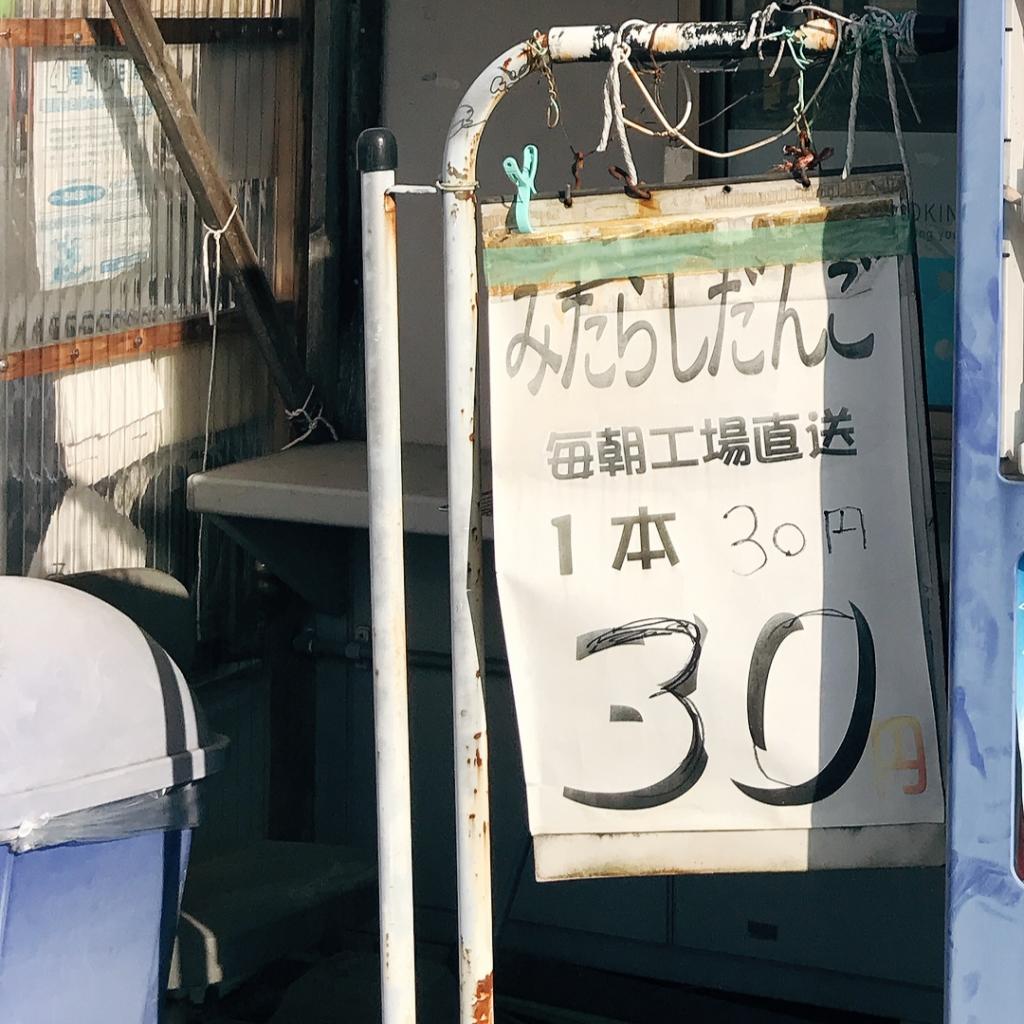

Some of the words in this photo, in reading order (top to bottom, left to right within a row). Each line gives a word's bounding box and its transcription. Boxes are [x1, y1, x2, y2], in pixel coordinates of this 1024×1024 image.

[506, 257, 875, 396] みたらしだんご
[546, 408, 857, 481] 毎朝工場直送
[550, 506, 679, 575] 1本
[564, 599, 876, 810] 30
